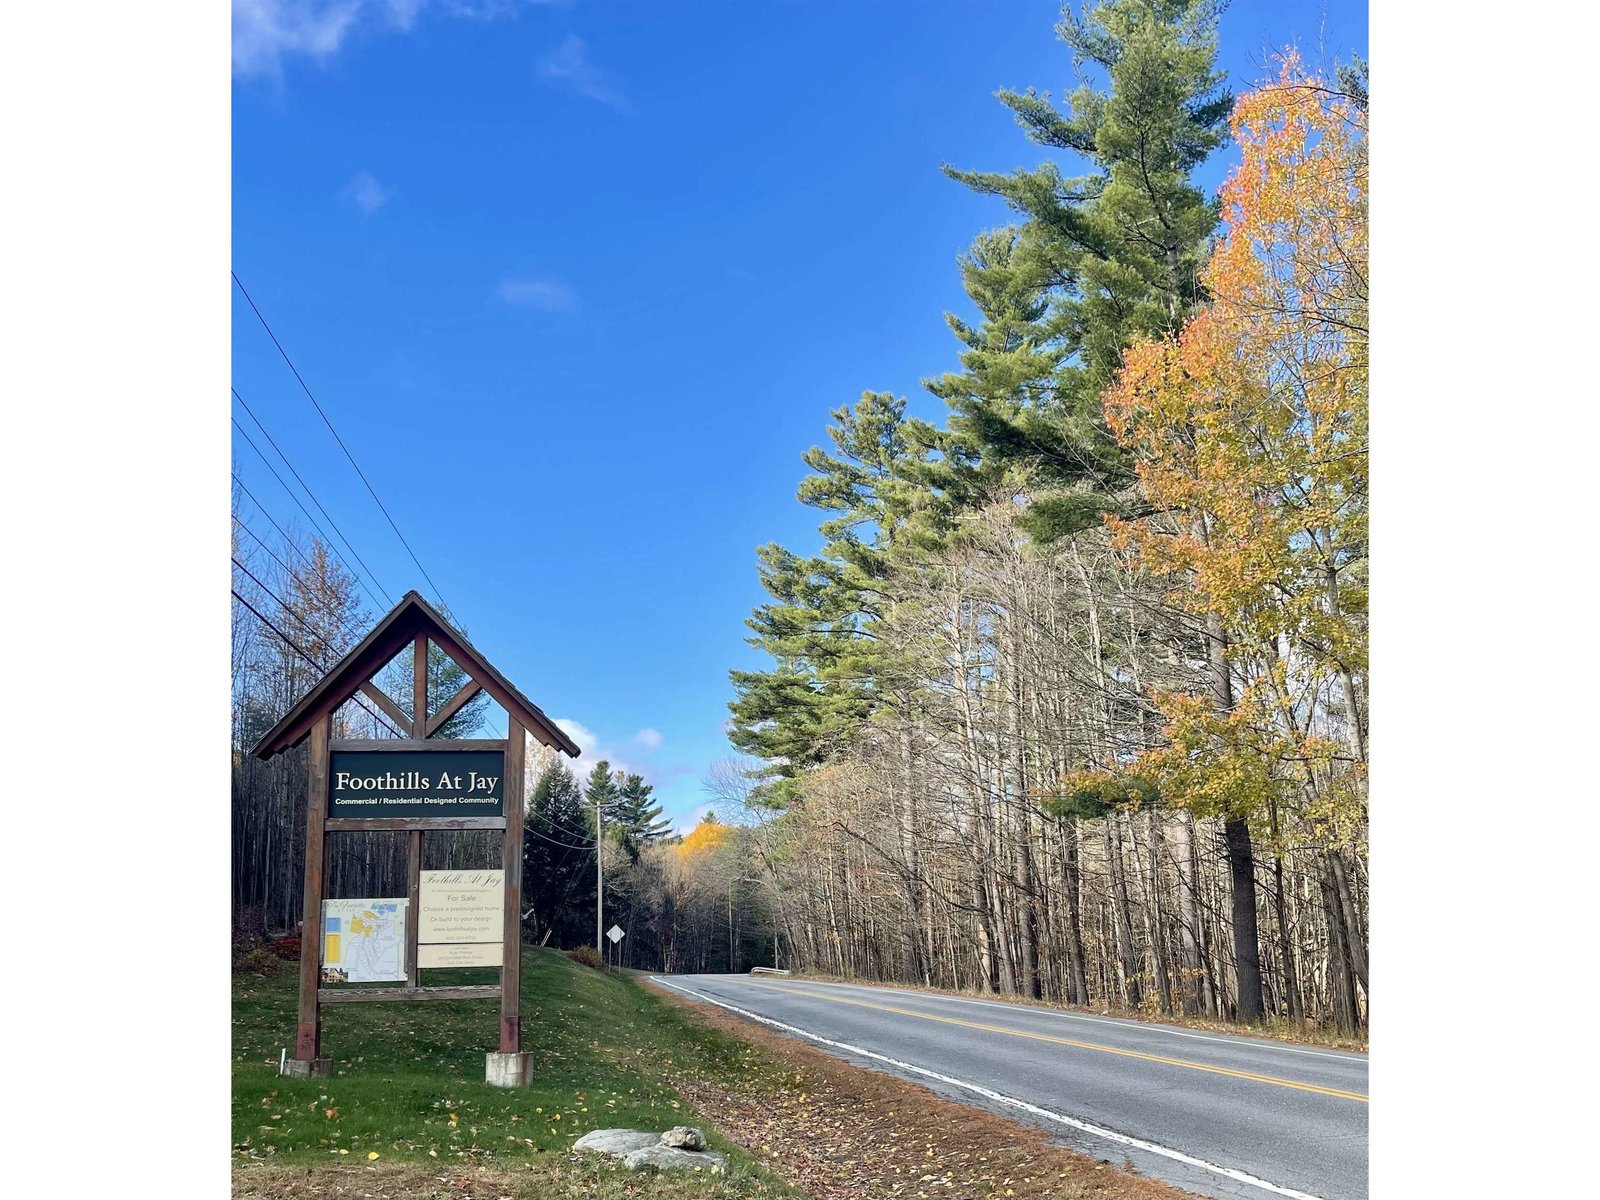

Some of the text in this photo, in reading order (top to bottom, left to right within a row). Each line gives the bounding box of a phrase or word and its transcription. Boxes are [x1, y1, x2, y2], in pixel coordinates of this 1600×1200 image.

[335, 771, 499, 794] Foothills At Jay
[335, 797, 378, 805] Commercial
[383, 797, 423, 805] Residential
[423, 797, 457, 806] Designed
[458, 796, 499, 805] Community
[422, 873, 502, 887] Foothills At Jay
